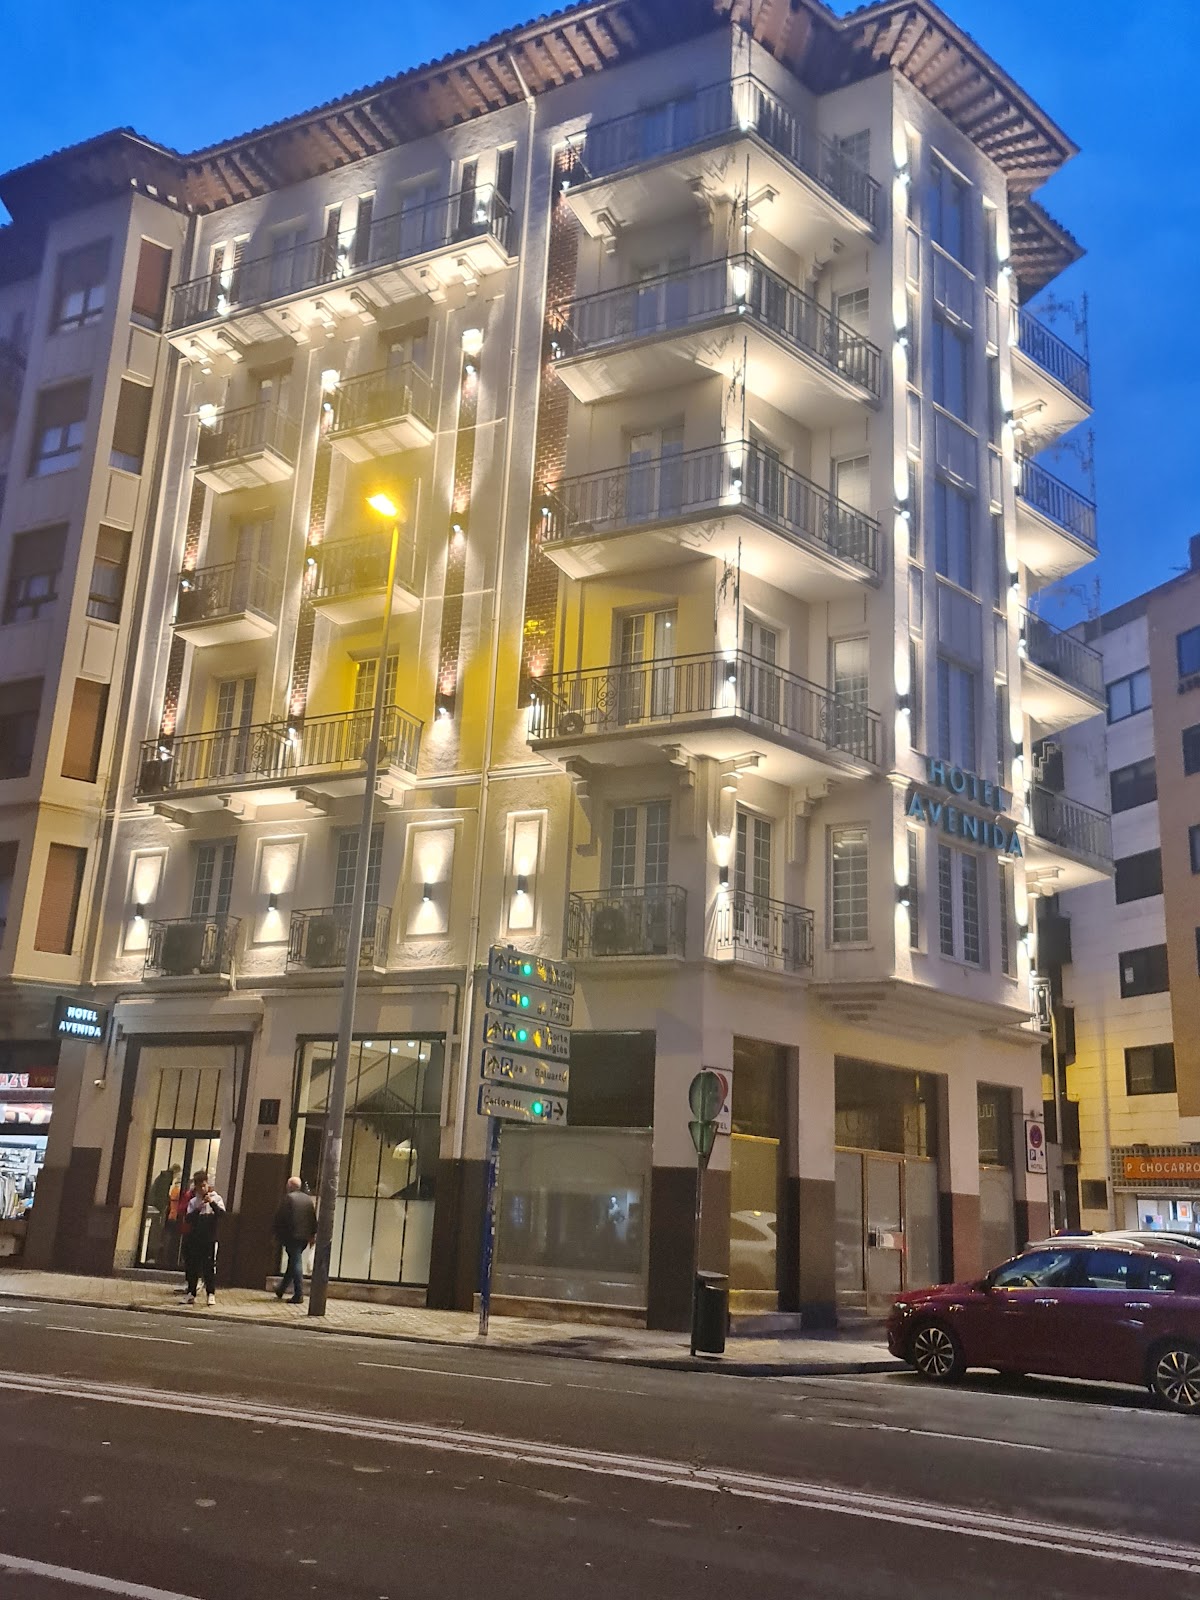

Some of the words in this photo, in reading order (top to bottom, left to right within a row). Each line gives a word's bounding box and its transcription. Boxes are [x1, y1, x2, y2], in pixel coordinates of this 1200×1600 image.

[928, 757, 1007, 812] HOTEL
[906, 791, 1023, 858] AVENIDA
[67, 1005, 98, 1022] HOTEL
[58, 1020, 101, 1037] AVENIDA
[483, 1094, 510, 1108] Carlos
[1139, 1162, 1200, 1173] CHOCARRO
